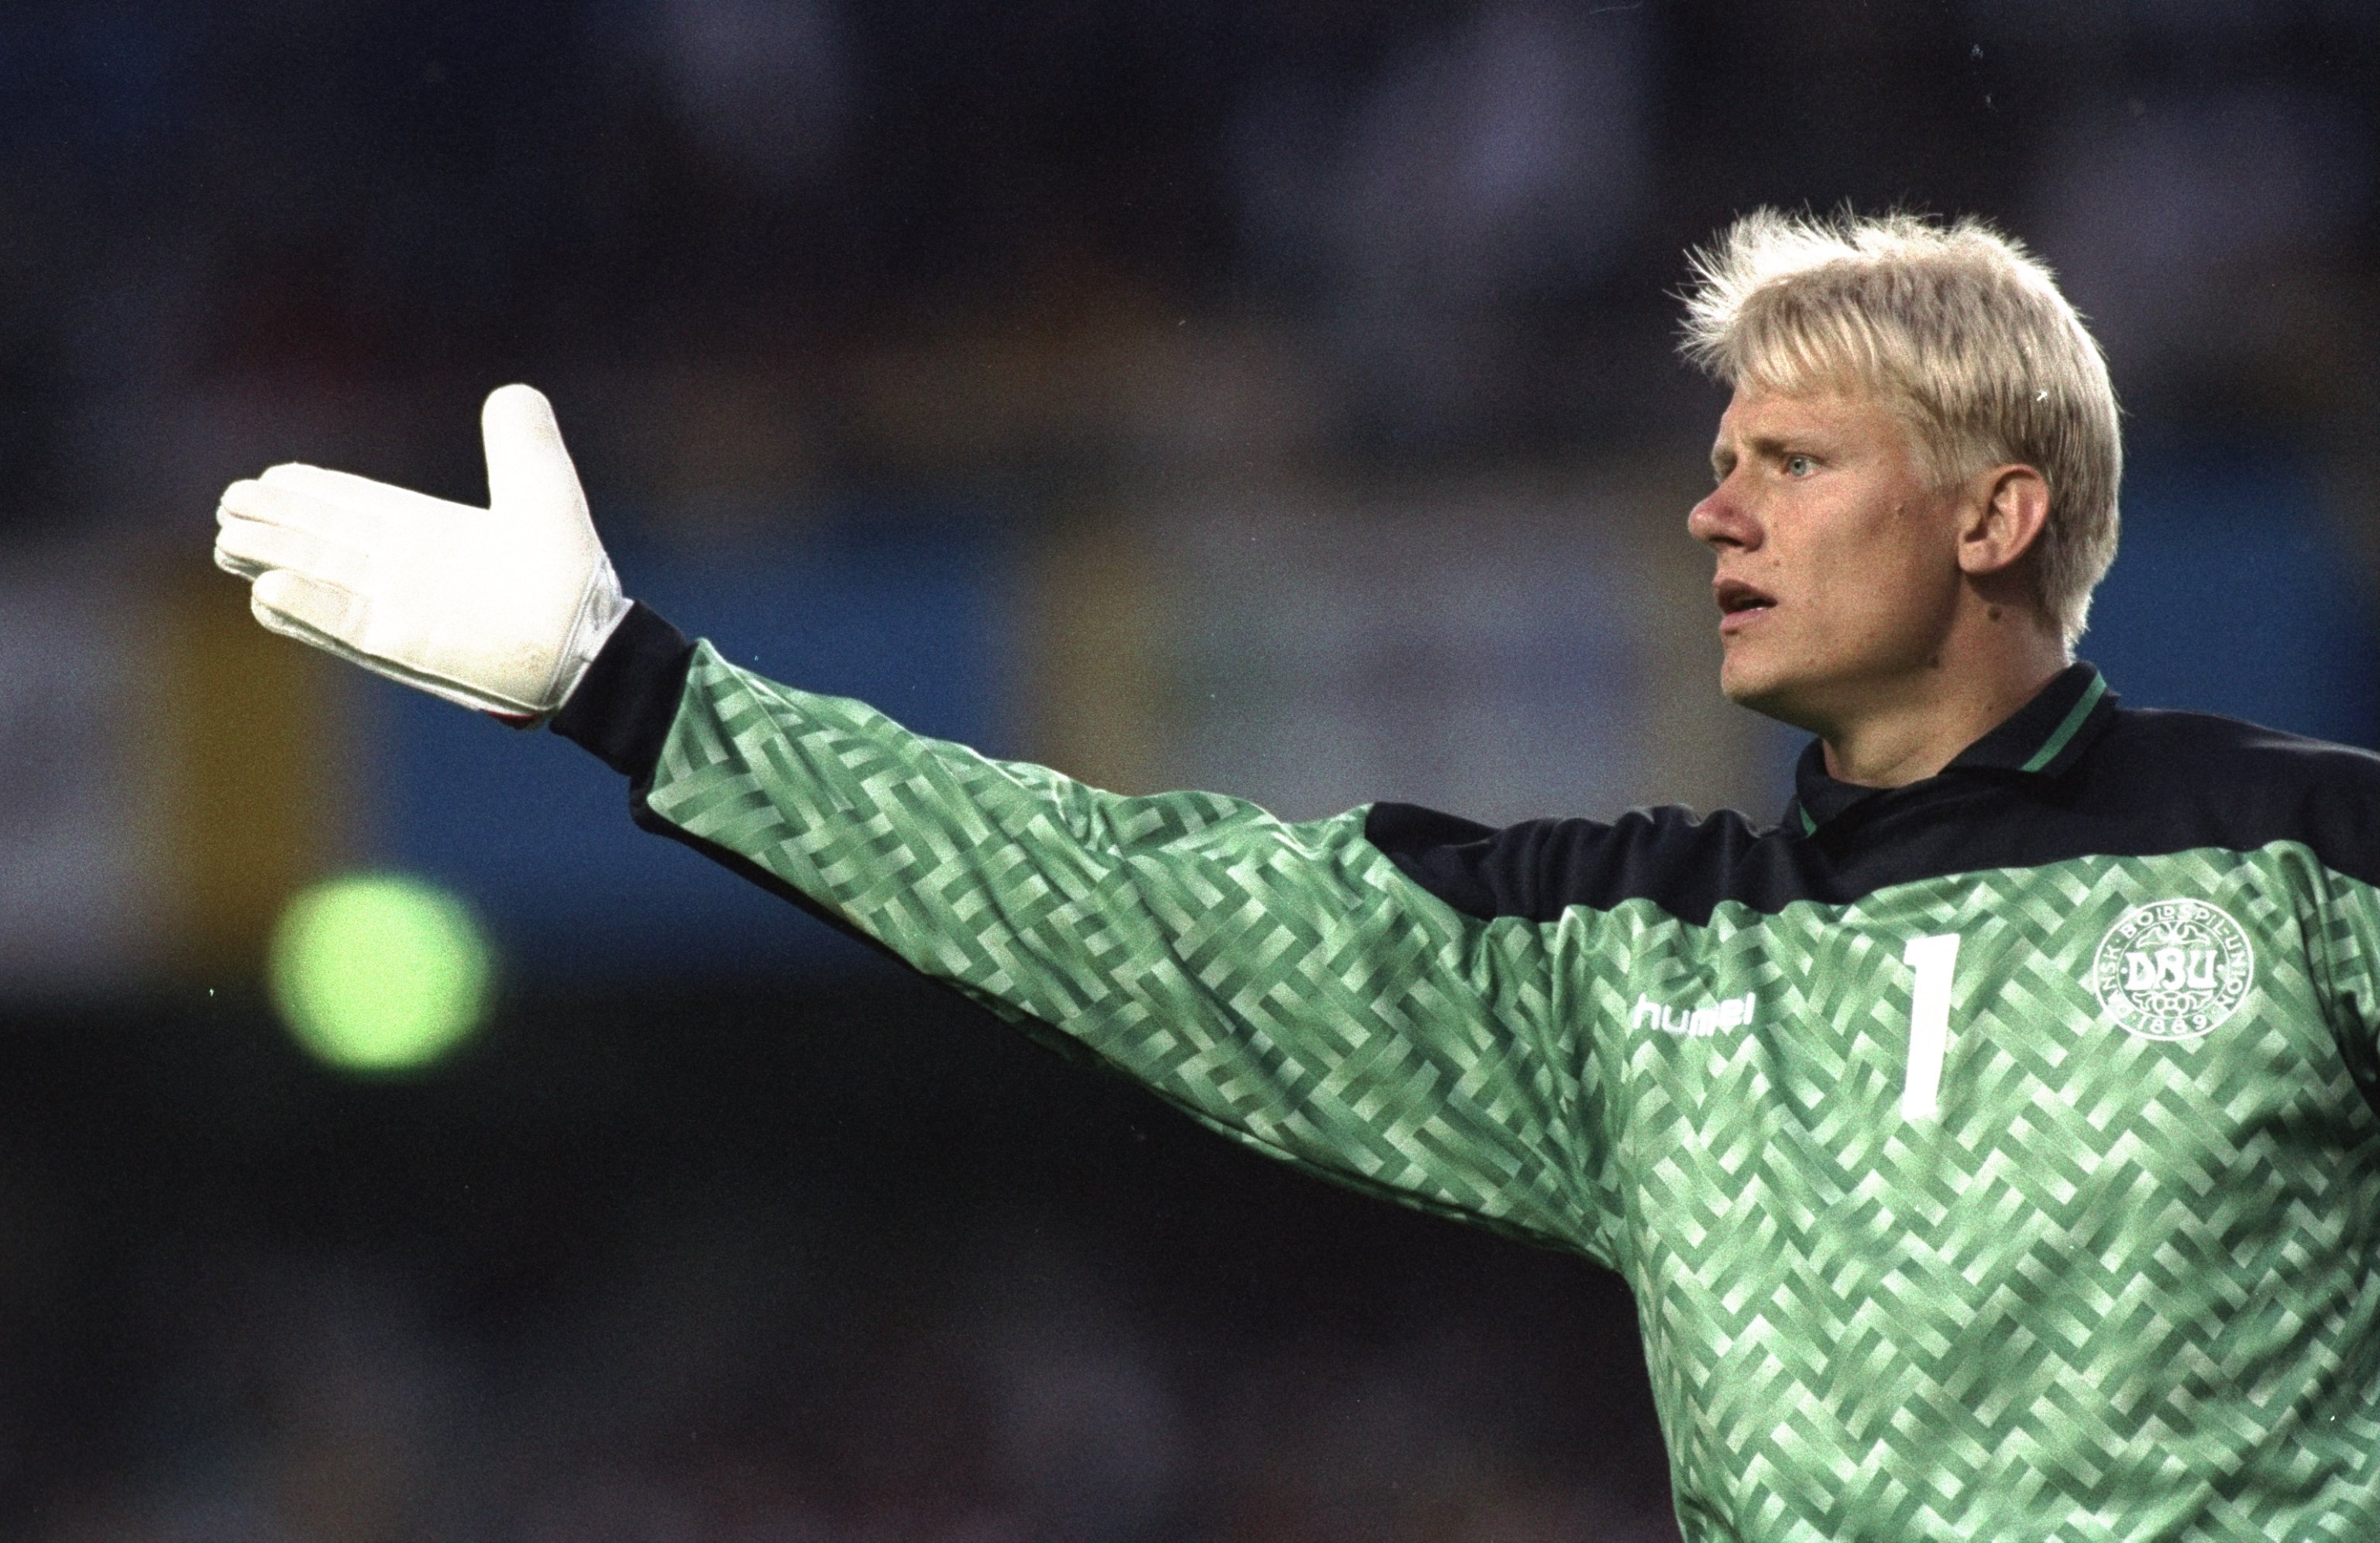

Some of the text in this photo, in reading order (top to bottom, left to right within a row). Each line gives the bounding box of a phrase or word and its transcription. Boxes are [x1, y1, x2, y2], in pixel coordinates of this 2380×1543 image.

[2125, 947, 2218, 991] DBU
[1632, 991, 1756, 1036] humel
[1903, 933, 1960, 1121] 1
[2138, 1014, 2208, 1035] 1889
